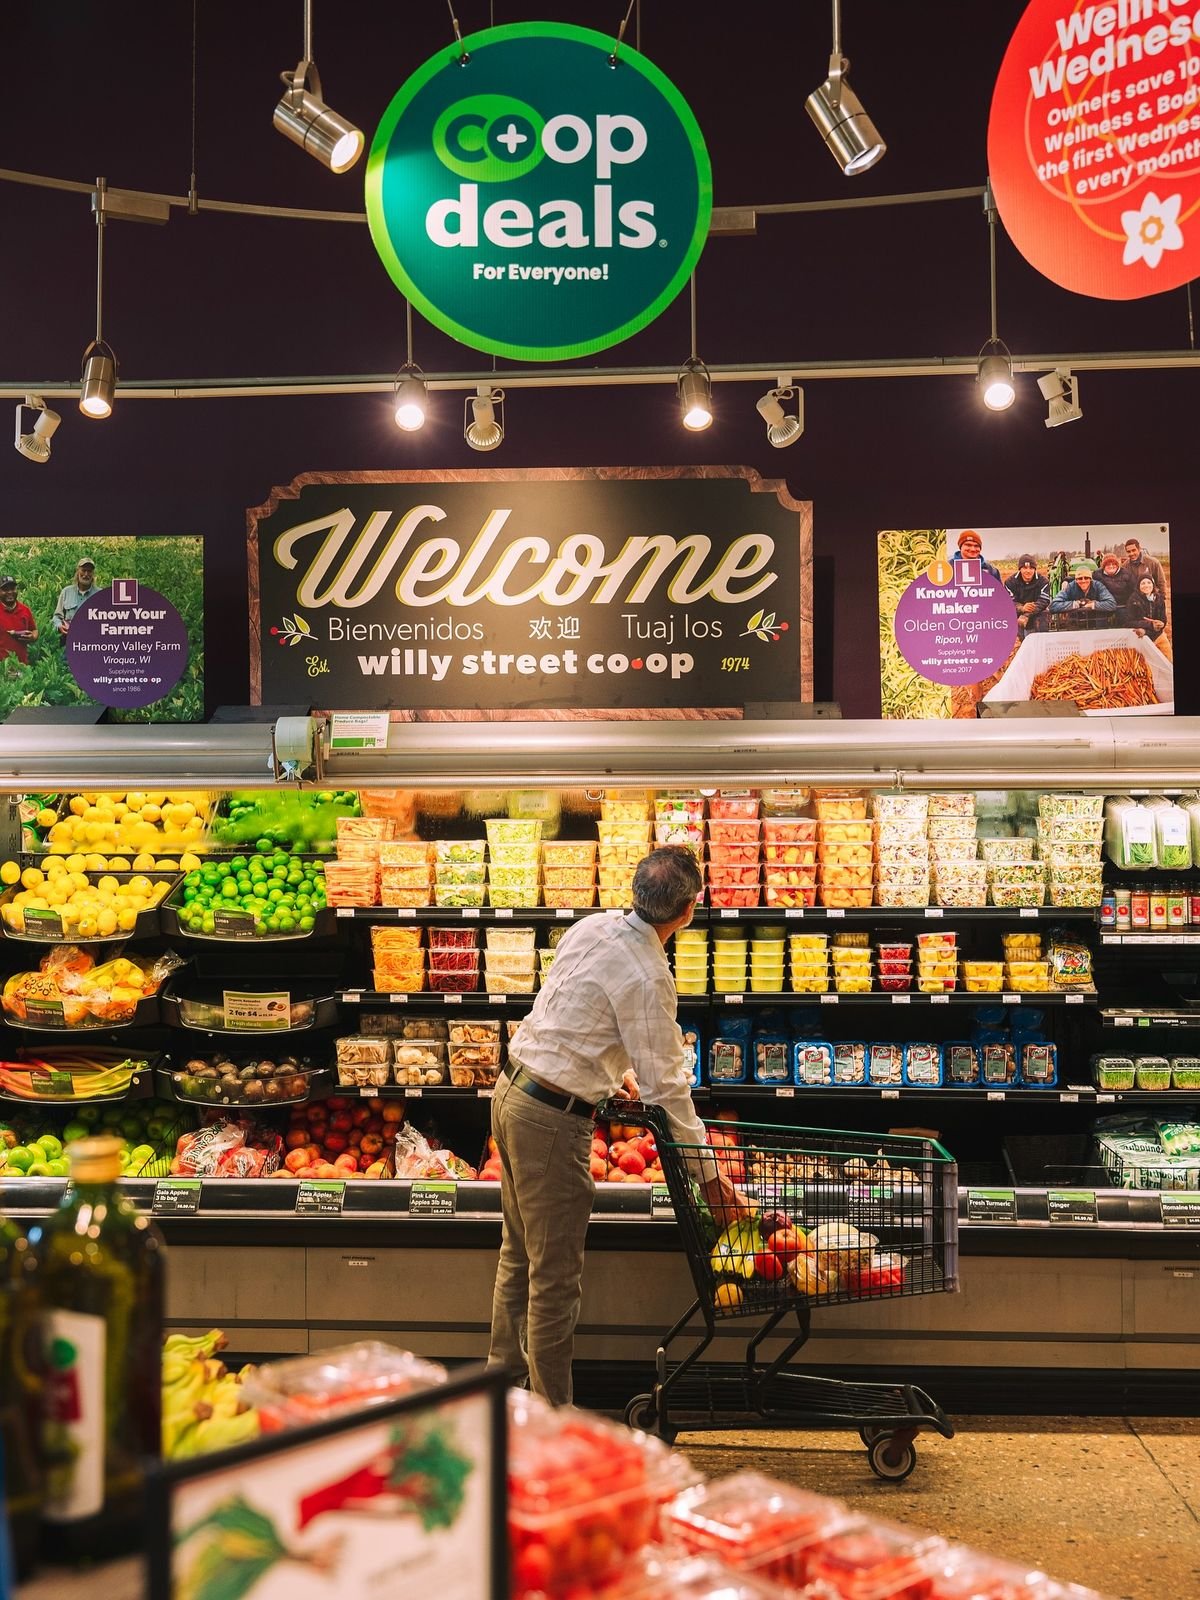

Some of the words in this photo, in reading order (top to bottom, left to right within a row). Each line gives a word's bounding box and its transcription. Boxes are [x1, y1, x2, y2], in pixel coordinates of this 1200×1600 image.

[1056, 0, 1190, 50] Welln
[1047, 88, 1121, 126] Owners
[1125, 69, 1175, 99] save
[1044, 111, 1133, 153] Wellness
[1136, 102, 1153, 121] &
[1037, 159, 1069, 181] the
[1072, 141, 1113, 170] first
[1076, 163, 1133, 194] every
[473, 263, 506, 280] For
[508, 263, 609, 285] Everyone!
[273, 504, 779, 610] Welcome
[119, 582, 132, 602] L
[916, 587, 958, 600] Know
[960, 586, 995, 599] Your
[88, 608, 130, 620] Know
[132, 608, 167, 620] Your
[932, 602, 980, 615] Maker
[101, 624, 154, 635] Farmer
[328, 616, 484, 641] Bienvenidos
[529, 616, 581, 640] 欢迎
[621, 614, 675, 645] Tuaj
[684, 613, 723, 639] los
[904, 619, 945, 632] Olden
[948, 617, 1009, 632] Organics
[72, 642, 120, 653] Harmony
[122, 641, 153, 653] Valley
[155, 641, 181, 651] Farm
[935, 634, 963, 646] Ripon,
[965, 634, 979, 643] WI
[103, 655, 137, 665] Viroqua,
[139, 655, 151, 664] WI
[921, 657, 942, 666] willy
[943, 657, 968, 665] street
[938, 649, 966, 657] Supplying
[305, 656, 331, 677] Est.
[357, 647, 453, 681] willy
[461, 650, 578, 675] street
[720, 656, 750, 673] 1974
[93, 676, 113, 684] willy
